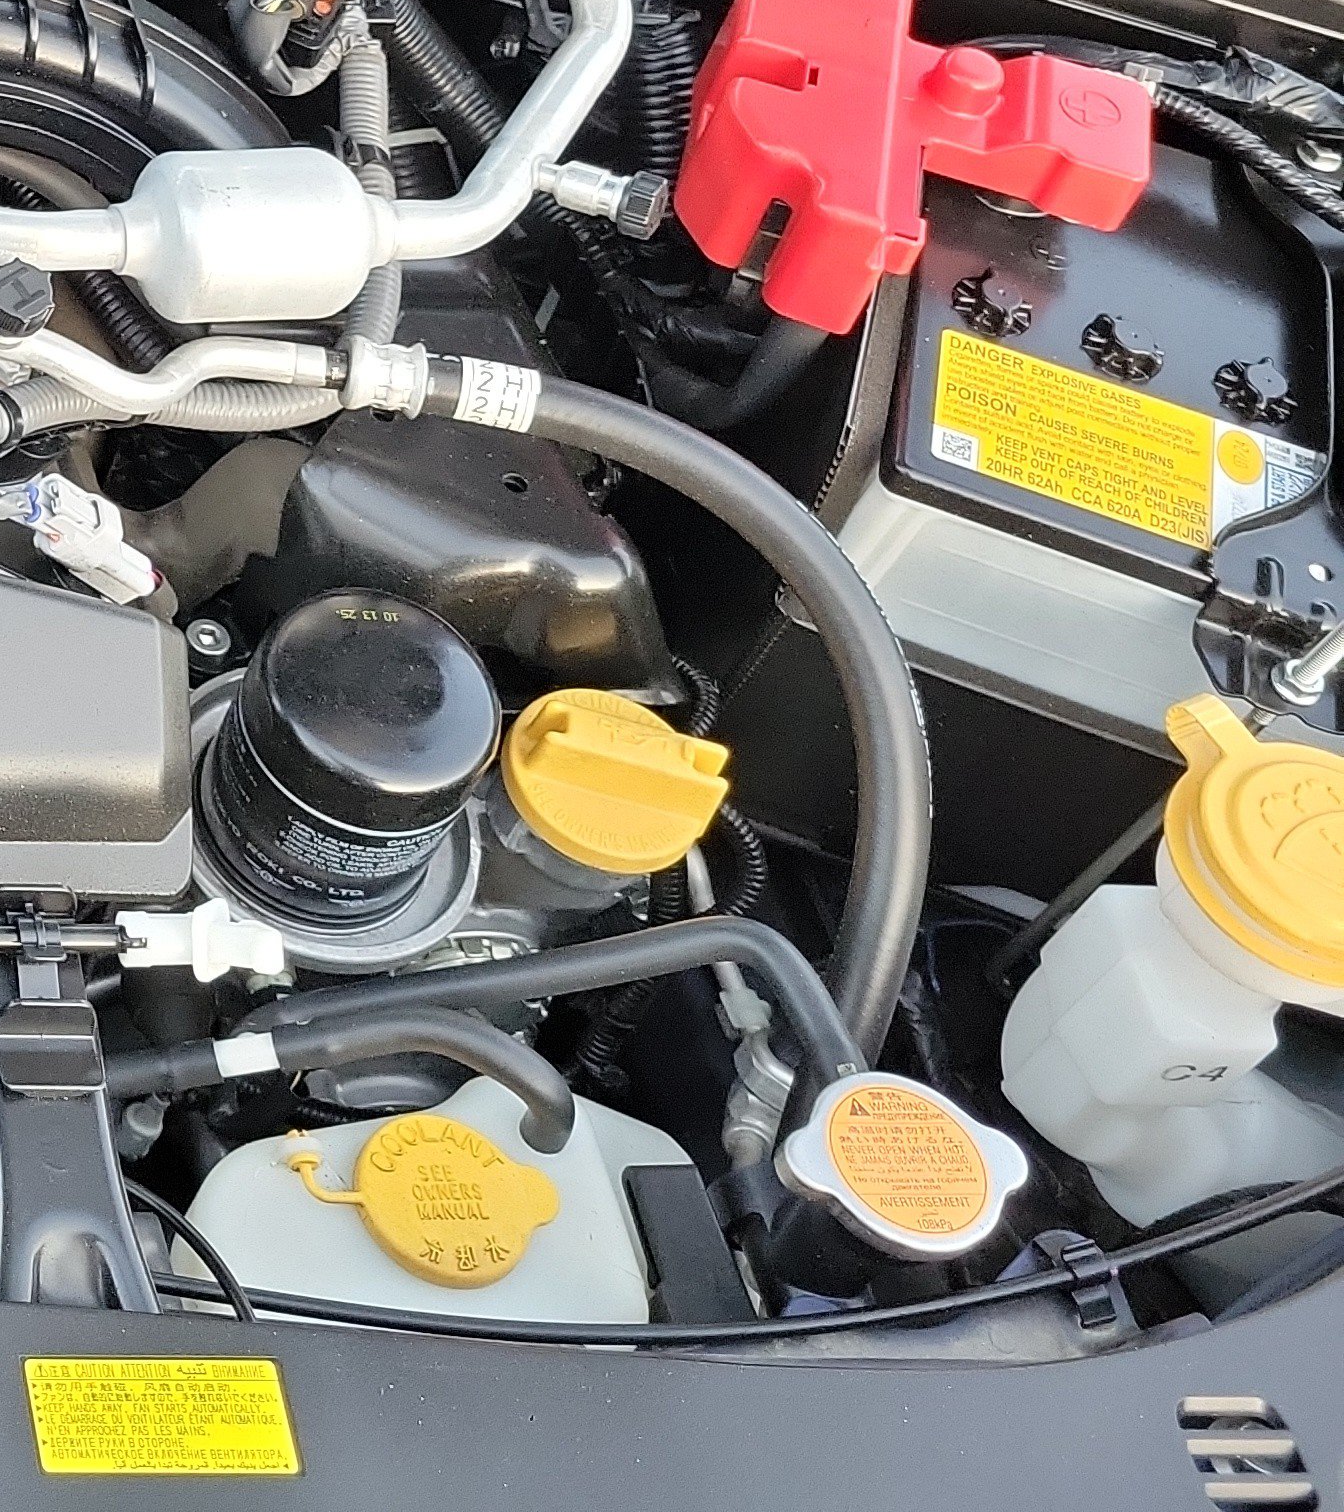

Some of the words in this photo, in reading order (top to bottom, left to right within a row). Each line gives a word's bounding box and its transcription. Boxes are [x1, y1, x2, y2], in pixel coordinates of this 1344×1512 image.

[949, 335, 1024, 371] DANGER
[1030, 363, 1097, 395] EXPLOSIVE
[1100, 387, 1141, 410] GASES
[945, 381, 1017, 418] POISON
[1028, 410, 1077, 437] CAUSES
[1080, 428, 1129, 455] SEVERE
[1132, 445, 1174, 470] BURNS
[995, 432, 1028, 453] KEEP
[1030, 444, 1062, 465] VENT
[1065, 456, 1099, 478] CAPS
[1103, 469, 1138, 491] TIGHT
[1140, 482, 1166, 501] AND
[1170, 492, 1209, 516] LEVEL
[994, 444, 1027, 465] KEEP
[1029, 456, 1055, 475] OUT
[1058, 466, 1075, 482] OF
[1078, 472, 1121, 498] REACH
[1124, 488, 1142, 505] OF
[1144, 495, 1206, 528] CHILDREN
[985, 455, 1024, 482] 20HR
[1026, 470, 1063, 496] 62Ah
[1071, 485, 1104, 509] CCA
[1106, 497, 1142, 523] 620A
[1149, 511, 1210, 549] D23(JIS)
[1161, 1064, 1228, 1081] C4
[868, 1101, 929, 1112] WARNING
[370, 1120, 505, 1173] COOLANT
[842, 1145, 875, 1155] NEVER
[879, 1145, 906, 1155] OPEN
[909, 1145, 941, 1155] WHEN
[846, 1155, 857, 1165] NE
[861, 1155, 892, 1165] JAMAIS
[895, 1155, 927, 1165] OUVRIR
[417, 1164, 457, 1183] SEE
[412, 1183, 483, 1202] OWNERS
[879, 1196, 972, 1208] AVERTISSEMENT
[416, 1202, 490, 1221] MANUAL
[916, 1218, 954, 1231] 108kPa
[73, 1362, 115, 1378] CAUTION
[118, 1363, 172, 1378] ATTENTION
[209, 1364, 266, 1378] ВНИМАНИЕ
[41, 1402, 66, 1412] KEEP
[68, 1402, 98, 1413] HANDS
[99, 1403, 128, 1413] AWAY.
[131, 1403, 151, 1413] FAN
[152, 1403, 188, 1413] STARTS
[190, 1403, 267, 1414] AUTOMATICALLY.
[44, 1413, 56, 1423] LE
[110, 1413, 123, 1424] DU
[125, 1414, 185, 1424] VENTILATEUR
[218, 1414, 283, 1425] AUTOMATIQUE.
[45, 1424, 71, 1435] N'EN
[73, 1424, 127, 1436] APPROCHEZ
[130, 1425, 150, 1436] PAS
[153, 1425, 173, 1436] LES
[175, 1425, 211, 1436] MAINS.
[47, 1436, 96, 1448] ДЕРЖИТЕ
[97, 1437, 126, 1448] РУКИ
[127, 1437, 136, 1447] В
[136, 1437, 190, 1448] СТОРОНЕ.
[49, 1448, 145, 1460] АВТОМАТИЧЕСКОЕ
[145, 1448, 208, 1460] ВКЛЮЧЕНИЕ
[209, 1448, 288, 1460] ВЕНТИЛЯТОРА.
